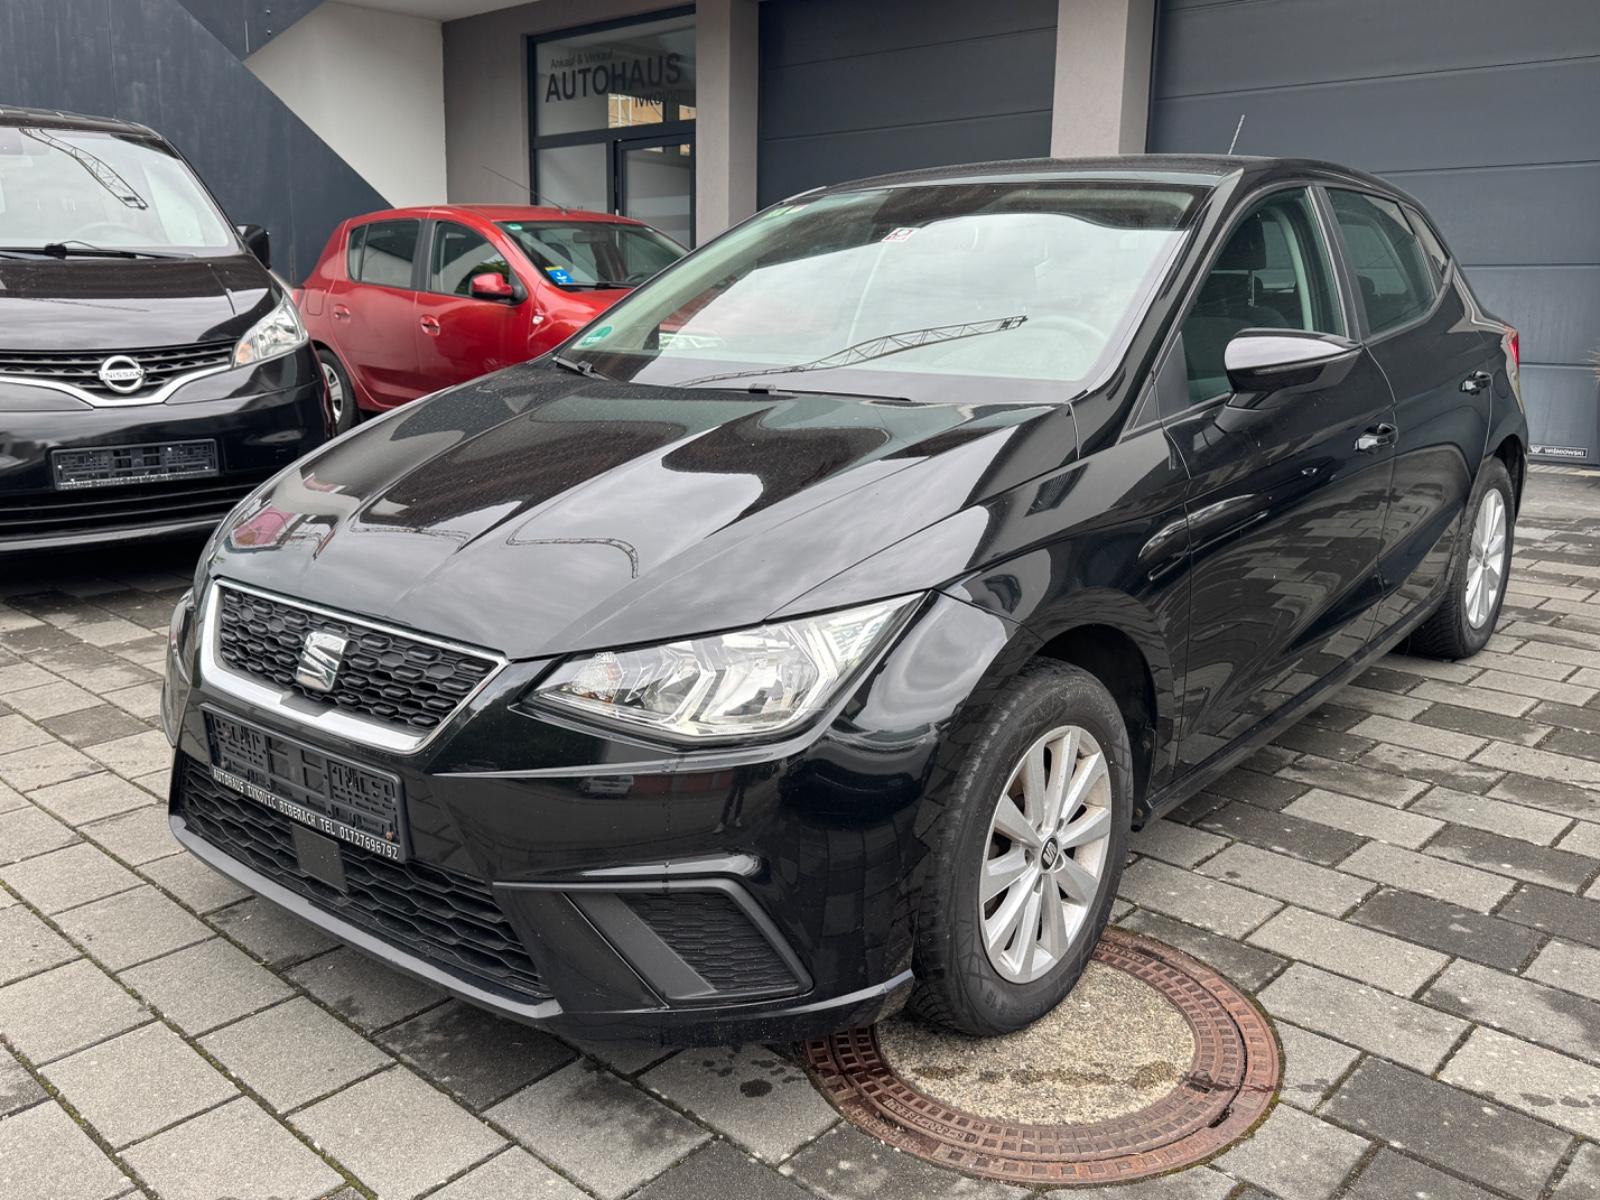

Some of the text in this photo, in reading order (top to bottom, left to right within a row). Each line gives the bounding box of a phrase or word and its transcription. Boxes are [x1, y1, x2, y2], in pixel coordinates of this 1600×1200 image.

[545, 52, 681, 103] AUTOHAUS
[104, 369, 142, 379] NISSAN
[280, 801, 317, 827] BIBERACH
[320, 818, 336, 835] TEL
[340, 826, 398, 860] 01727696792
